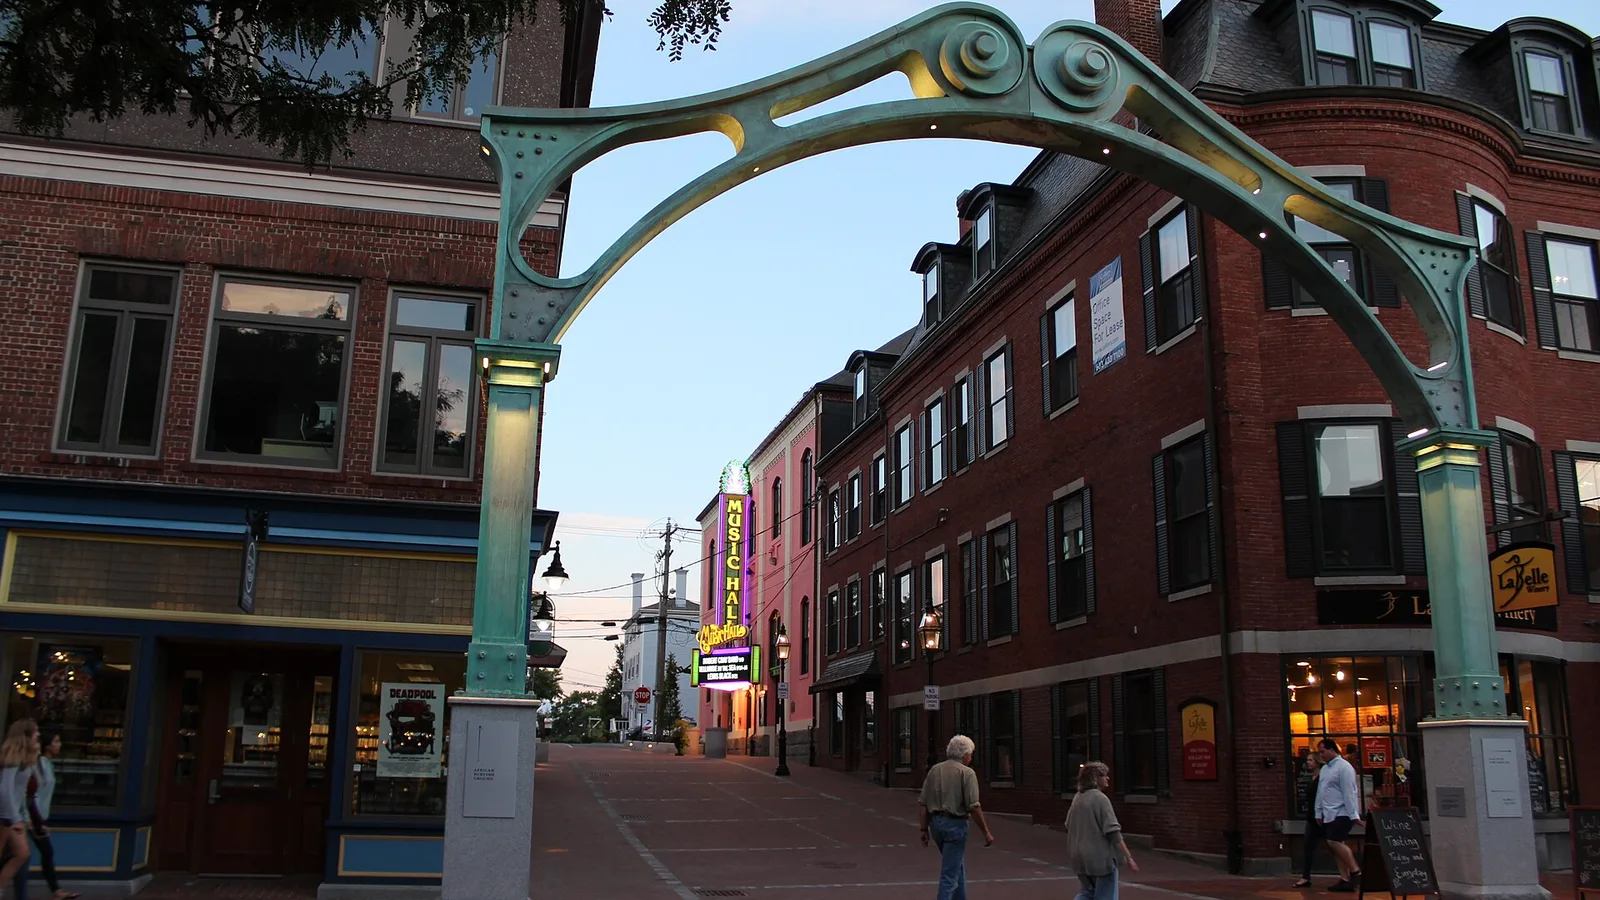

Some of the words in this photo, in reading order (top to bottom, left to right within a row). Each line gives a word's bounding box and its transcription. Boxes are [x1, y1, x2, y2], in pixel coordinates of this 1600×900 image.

[1093, 296, 1110, 315] Office
[1093, 312, 1111, 330] Space
[1094, 330, 1105, 344] For
[1106, 319, 1123, 337] Lease
[727, 499, 742, 570] MUSIC
[1498, 562, 1549, 596] LaBelle
[1526, 585, 1550, 594] Winery
[389, 688, 437, 700] DEADPOOL
[635, 691, 650, 699] STOP
[1380, 818, 1412, 831] Wine
[1384, 835, 1420, 851] Tasting
